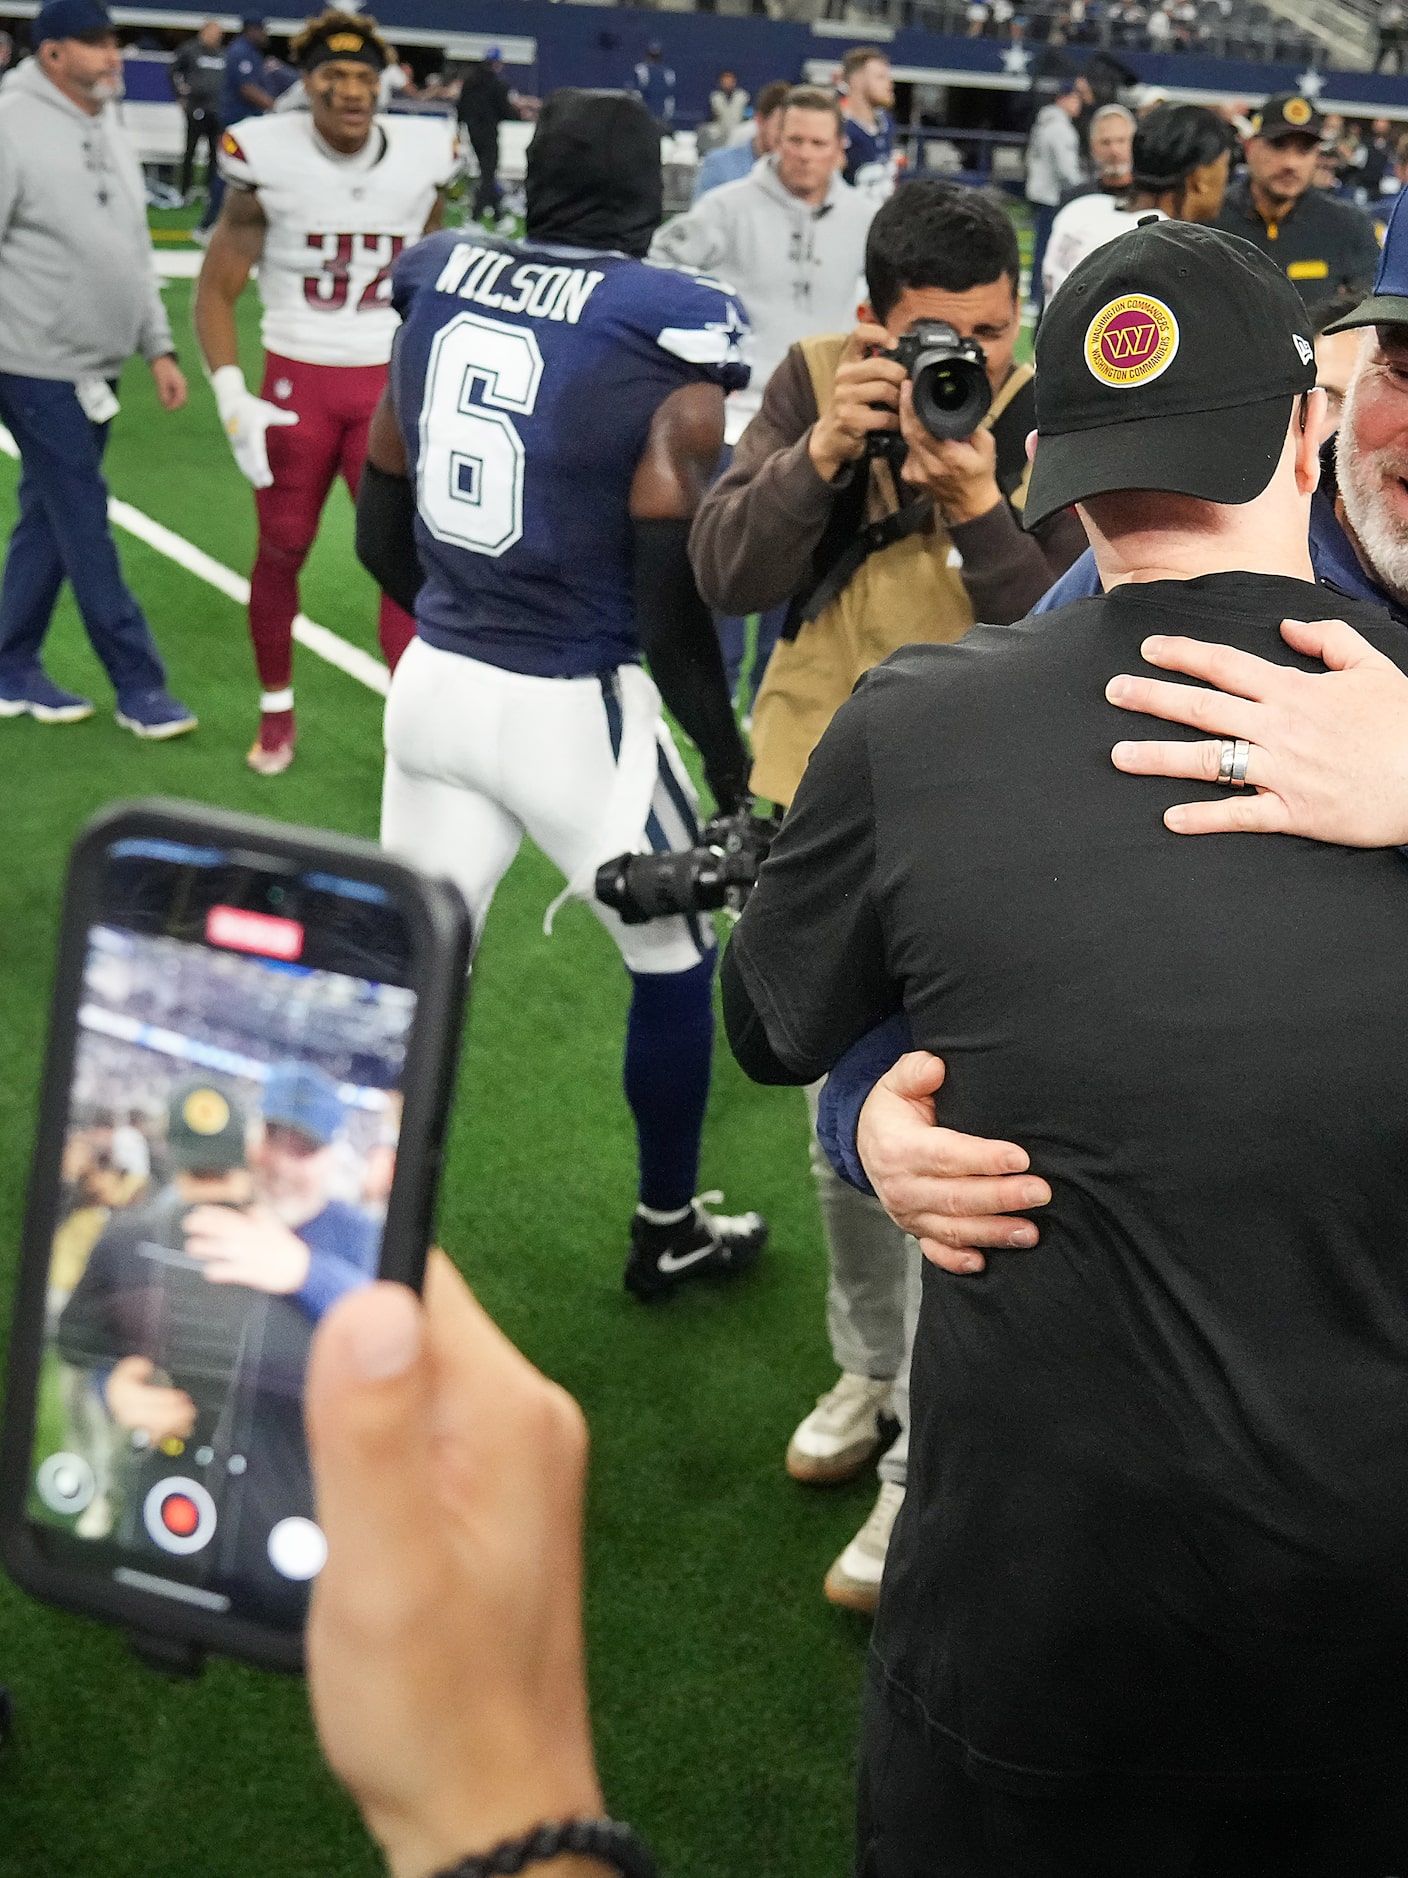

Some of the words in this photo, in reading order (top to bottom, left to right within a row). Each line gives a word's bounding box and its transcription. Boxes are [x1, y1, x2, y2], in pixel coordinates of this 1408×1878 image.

[304, 233, 403, 313] 32
[435, 243, 606, 324] WILSON
[1092, 301, 1126, 344] WASHINGTON
[1127, 299, 1170, 333] COMMANDERS
[1092, 348, 1127, 380] WASHINGTON
[1129, 336, 1170, 379] COMMANDERS
[416, 310, 545, 558] 6
